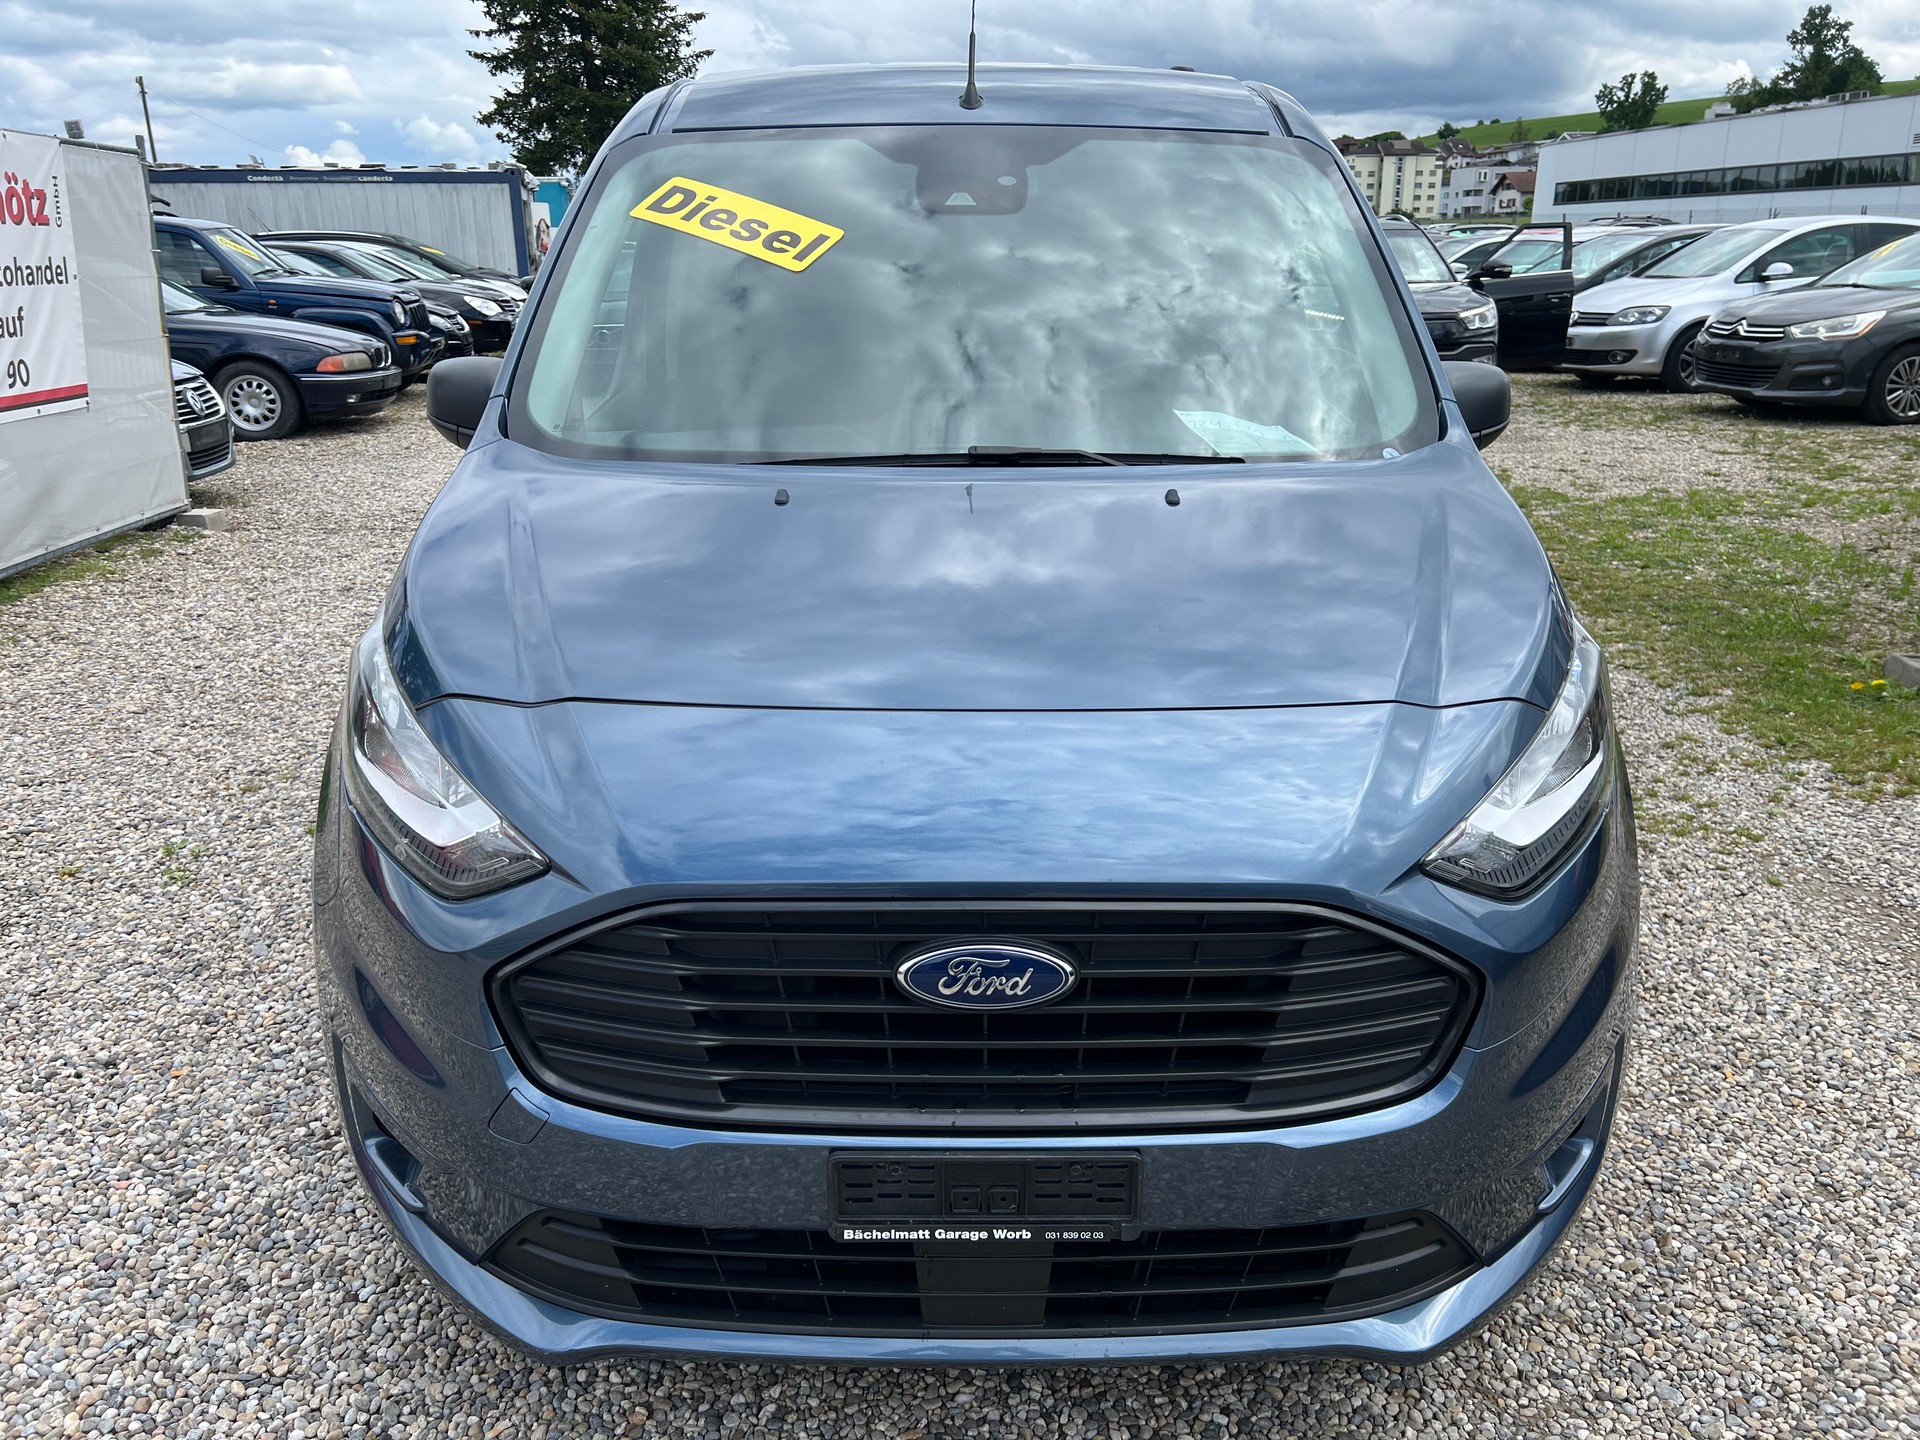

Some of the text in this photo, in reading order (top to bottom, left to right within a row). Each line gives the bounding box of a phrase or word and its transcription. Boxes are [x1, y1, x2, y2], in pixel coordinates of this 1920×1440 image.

[52, 176, 62, 228] GmbH
[645, 185, 831, 263] Diesel
[7, 358, 30, 389] 90
[937, 956, 1034, 996] Ford
[843, 1228, 1104, 1241] Bächelmatt Garage Worb 031 839 02 03
